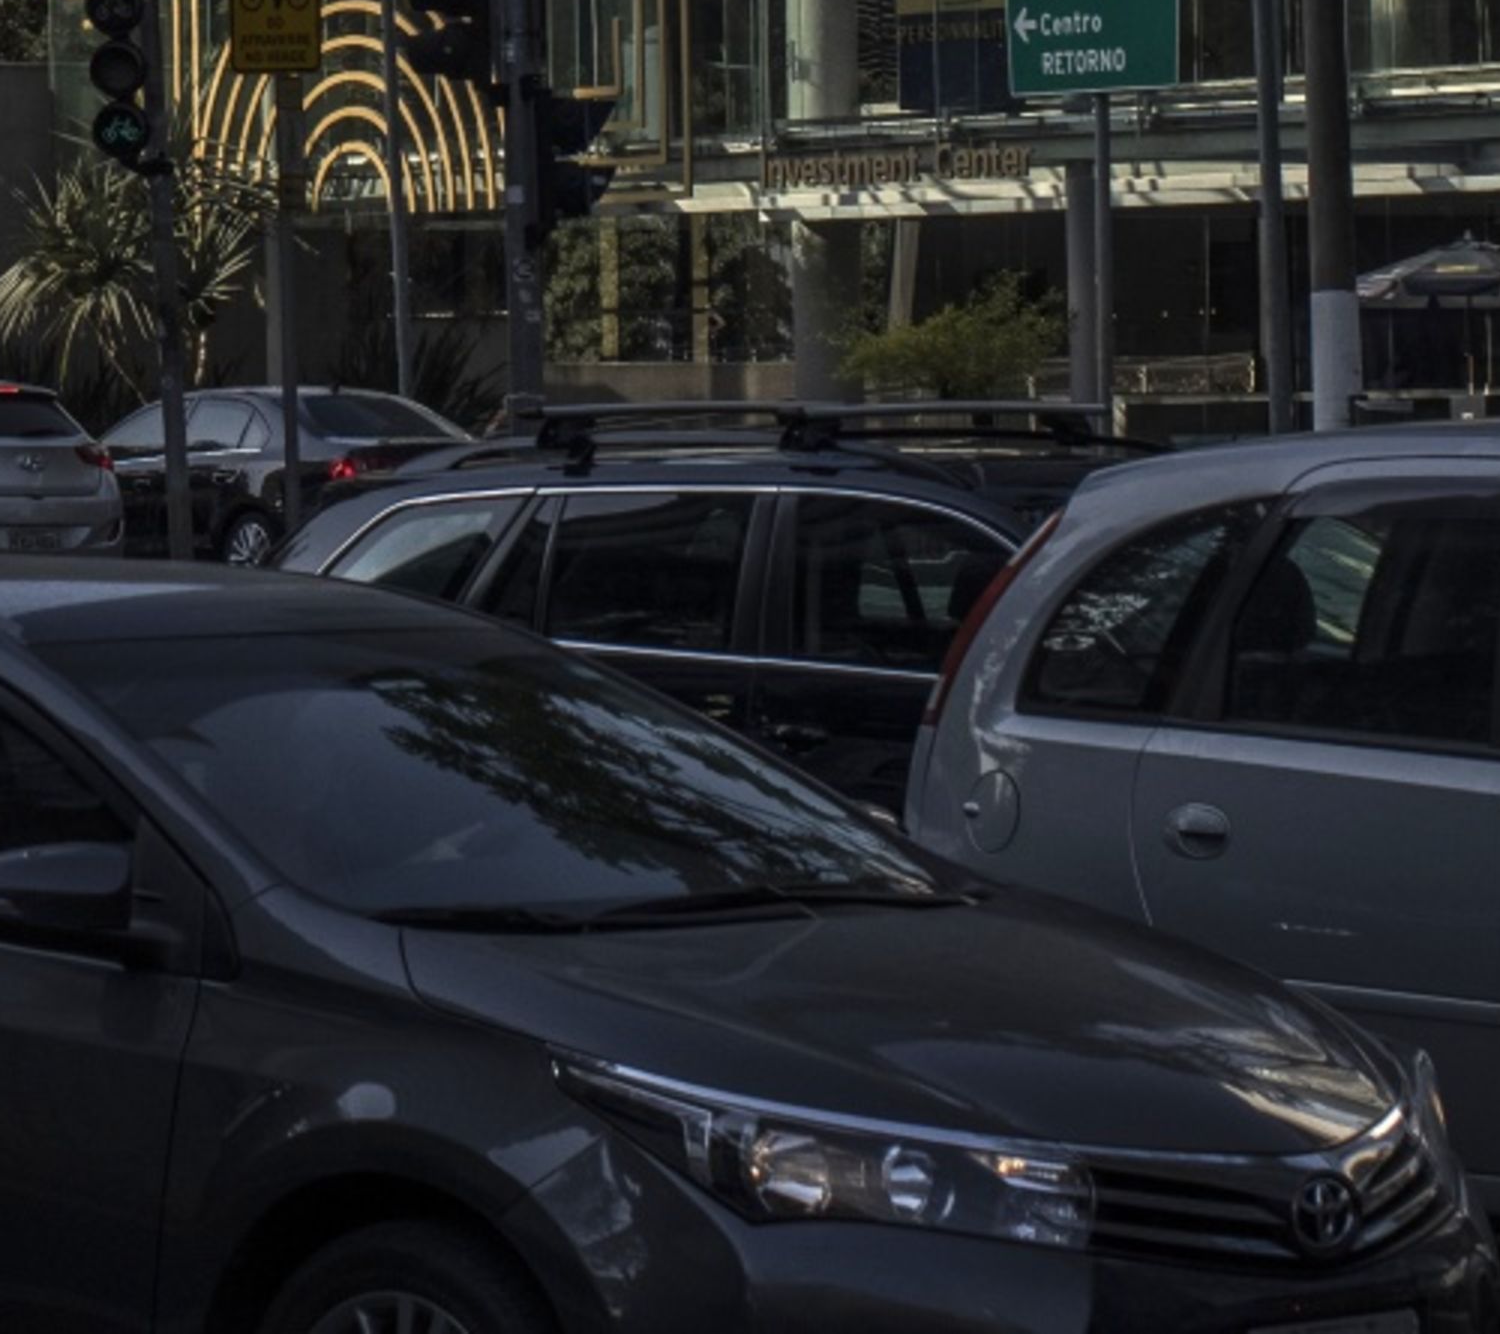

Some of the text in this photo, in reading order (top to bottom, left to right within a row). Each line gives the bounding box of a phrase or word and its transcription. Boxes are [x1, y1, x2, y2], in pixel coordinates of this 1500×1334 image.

[1039, 11, 1103, 37] Centro
[1041, 47, 1128, 75] RETORNO
[761, 135, 1032, 189] Investment Center
